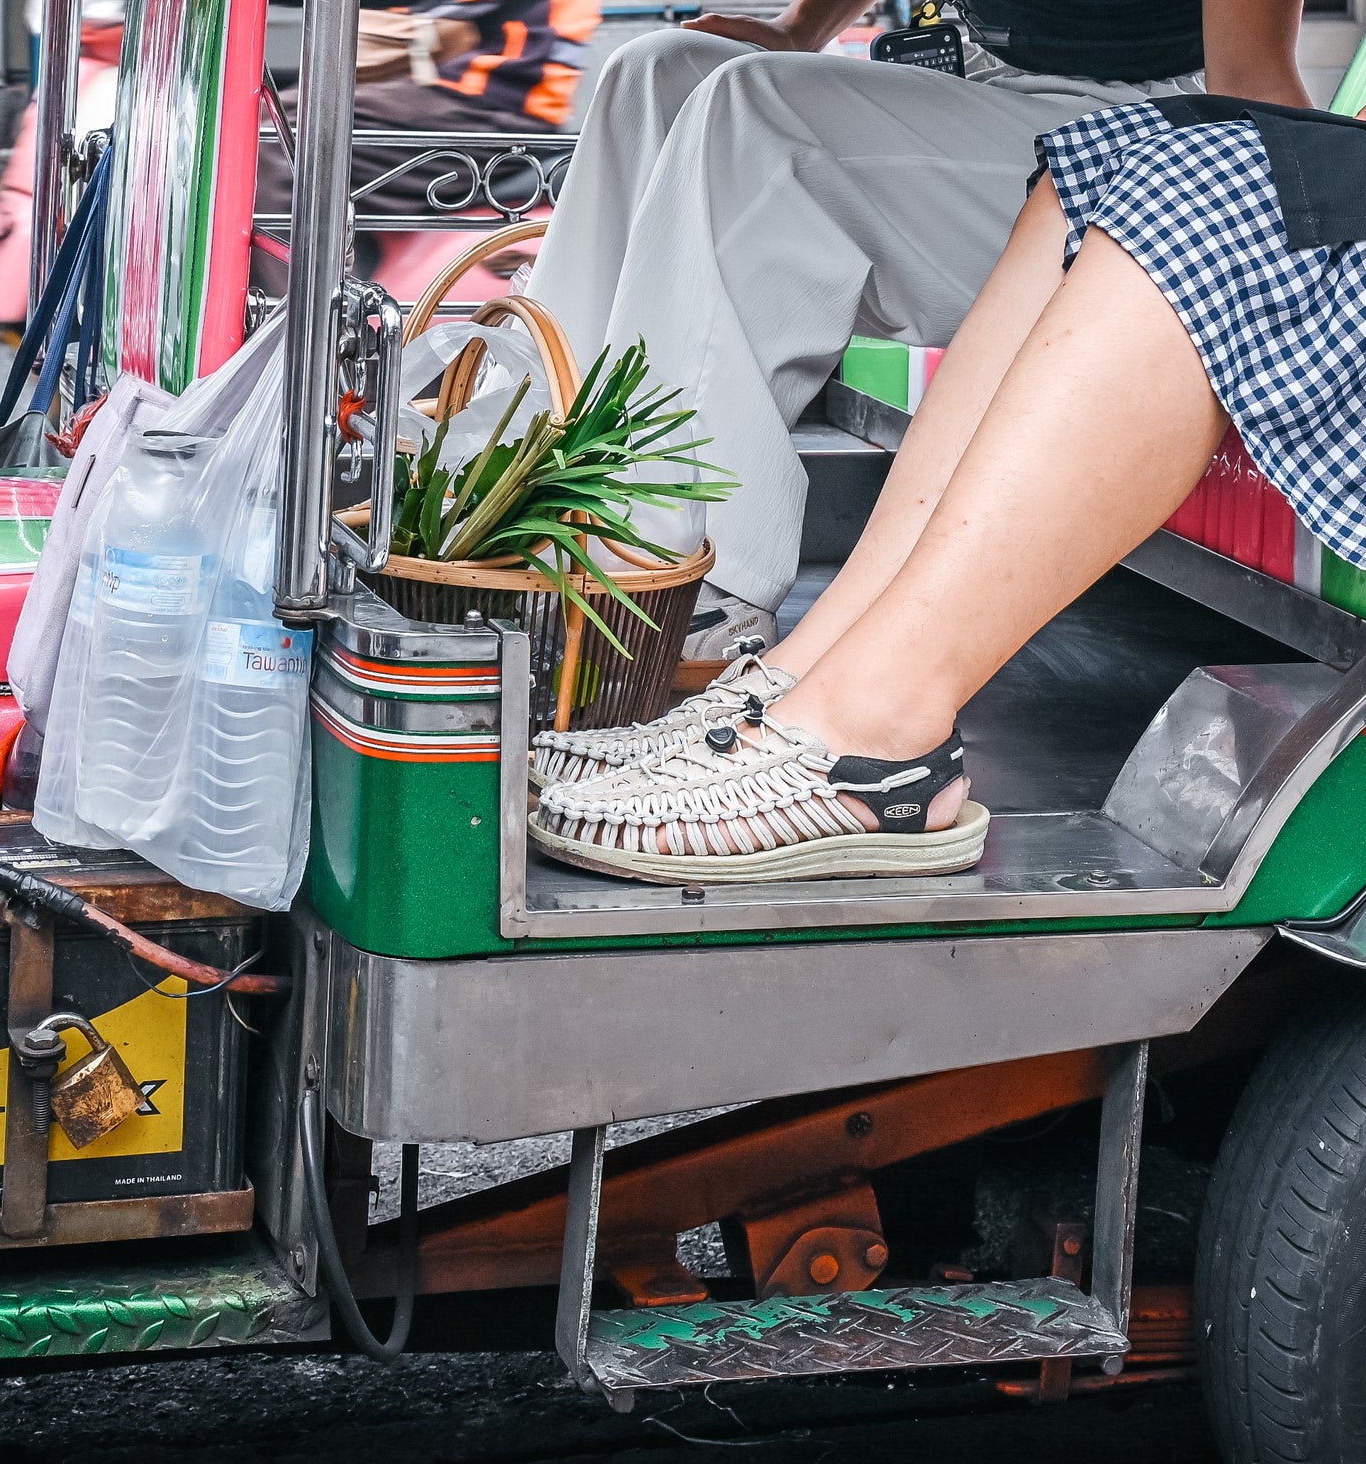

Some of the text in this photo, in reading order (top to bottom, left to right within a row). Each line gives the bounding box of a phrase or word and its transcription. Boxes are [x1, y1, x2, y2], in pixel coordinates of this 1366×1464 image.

[885, 805, 920, 817] KEEN
[114, 1178, 135, 1186] MADE
[146, 1173, 182, 1183] THAILAND
